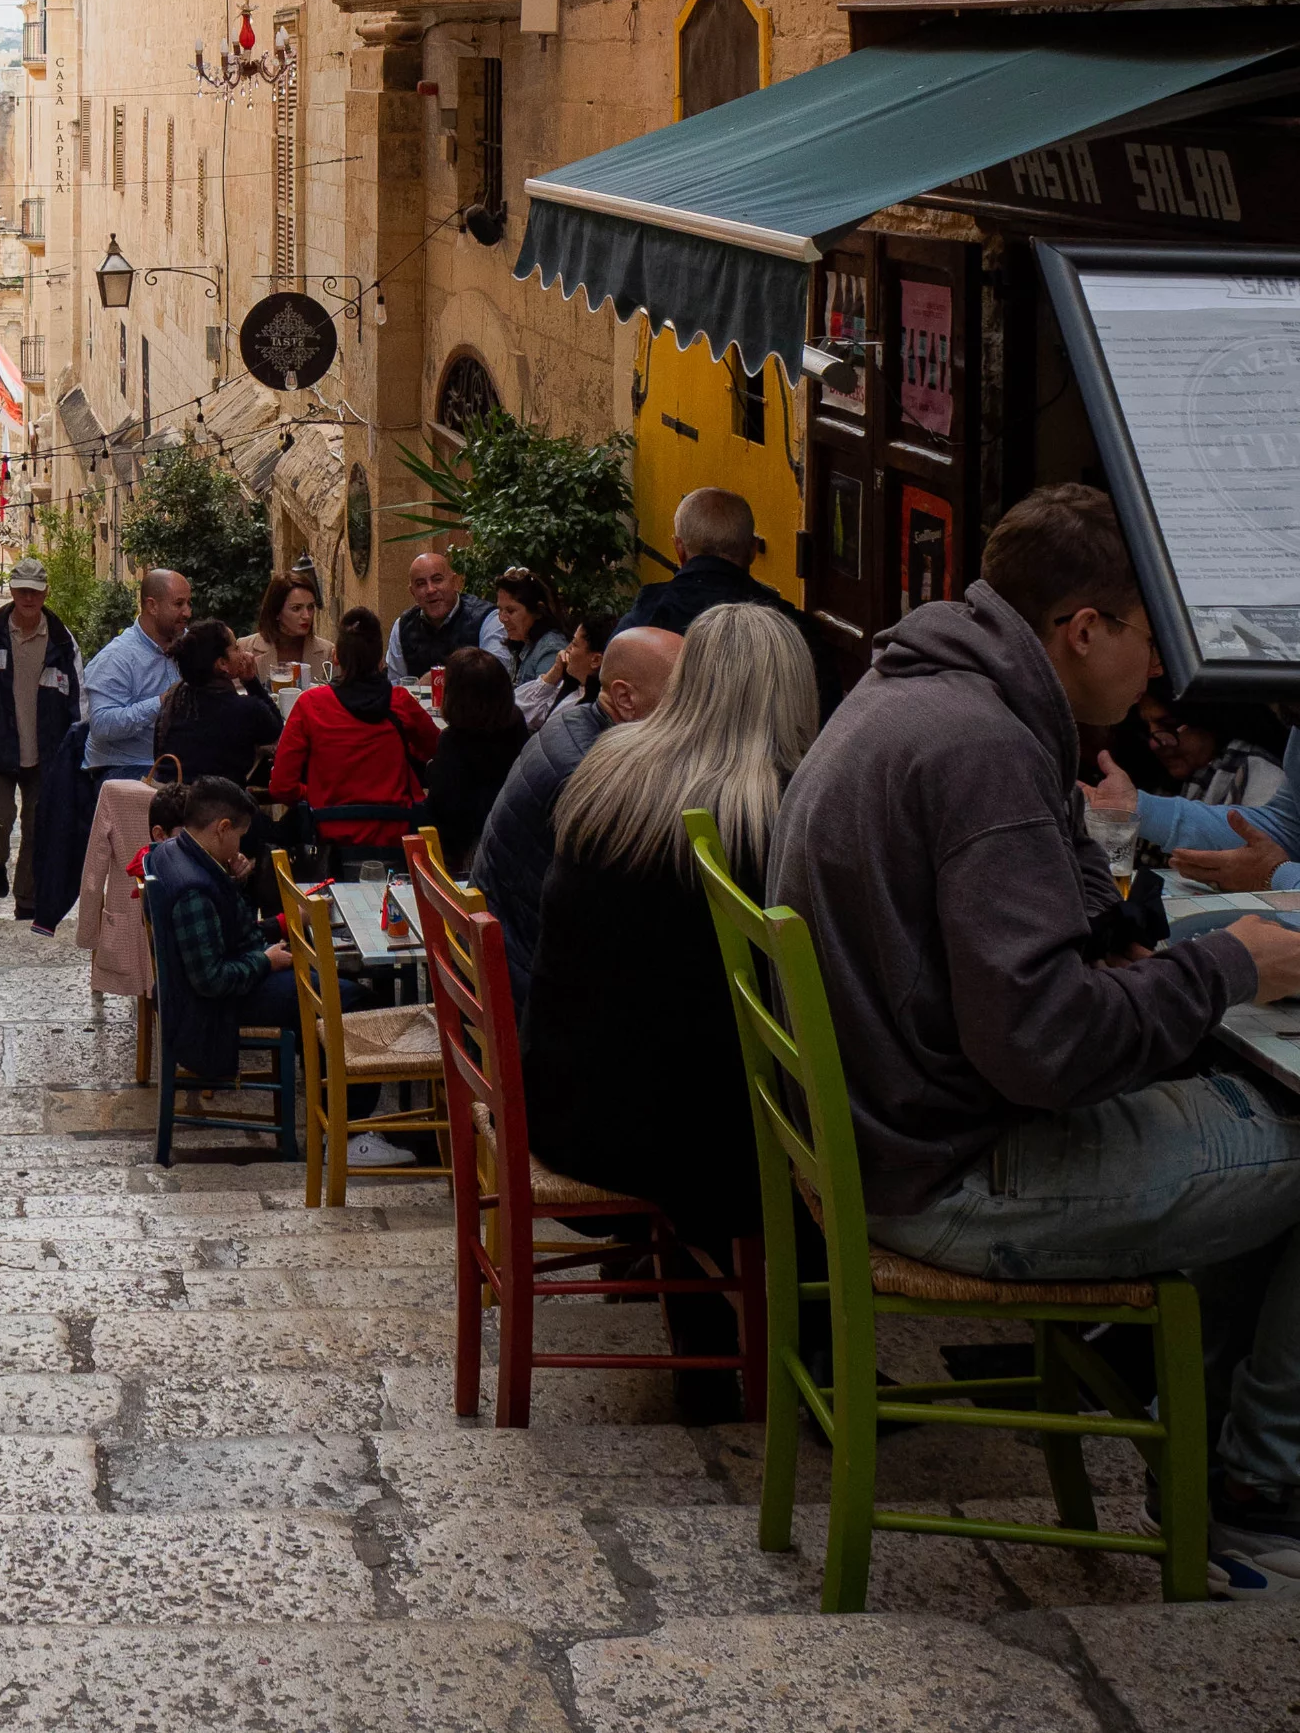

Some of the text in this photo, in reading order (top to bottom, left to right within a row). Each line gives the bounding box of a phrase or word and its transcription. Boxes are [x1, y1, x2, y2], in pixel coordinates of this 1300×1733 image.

[55, 57, 65, 193] CASA LAPIRA
[1009, 142, 1242, 222] PASTA SALAD
